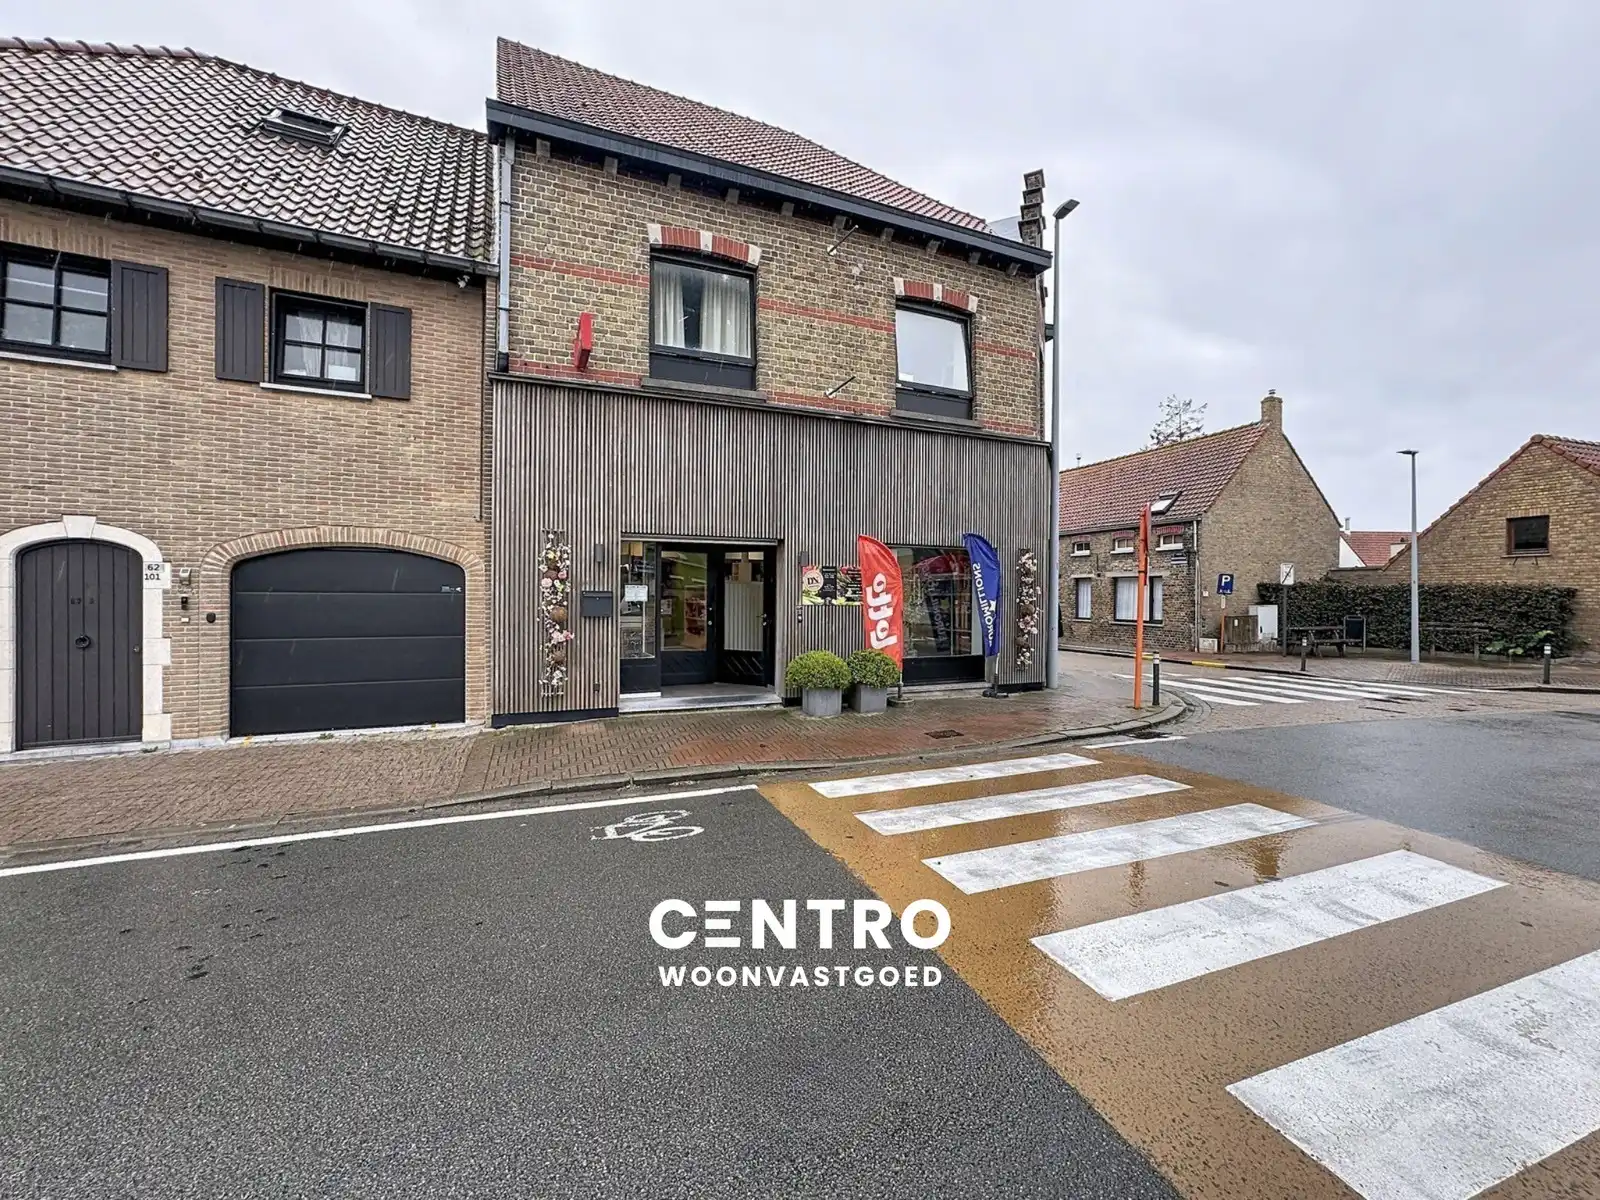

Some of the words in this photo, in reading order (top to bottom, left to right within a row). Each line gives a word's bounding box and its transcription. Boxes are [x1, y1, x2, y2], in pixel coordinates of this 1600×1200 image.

[147, 563, 160, 571] 62
[144, 573, 161, 581] 101
[1221, 575, 1231, 586] P
